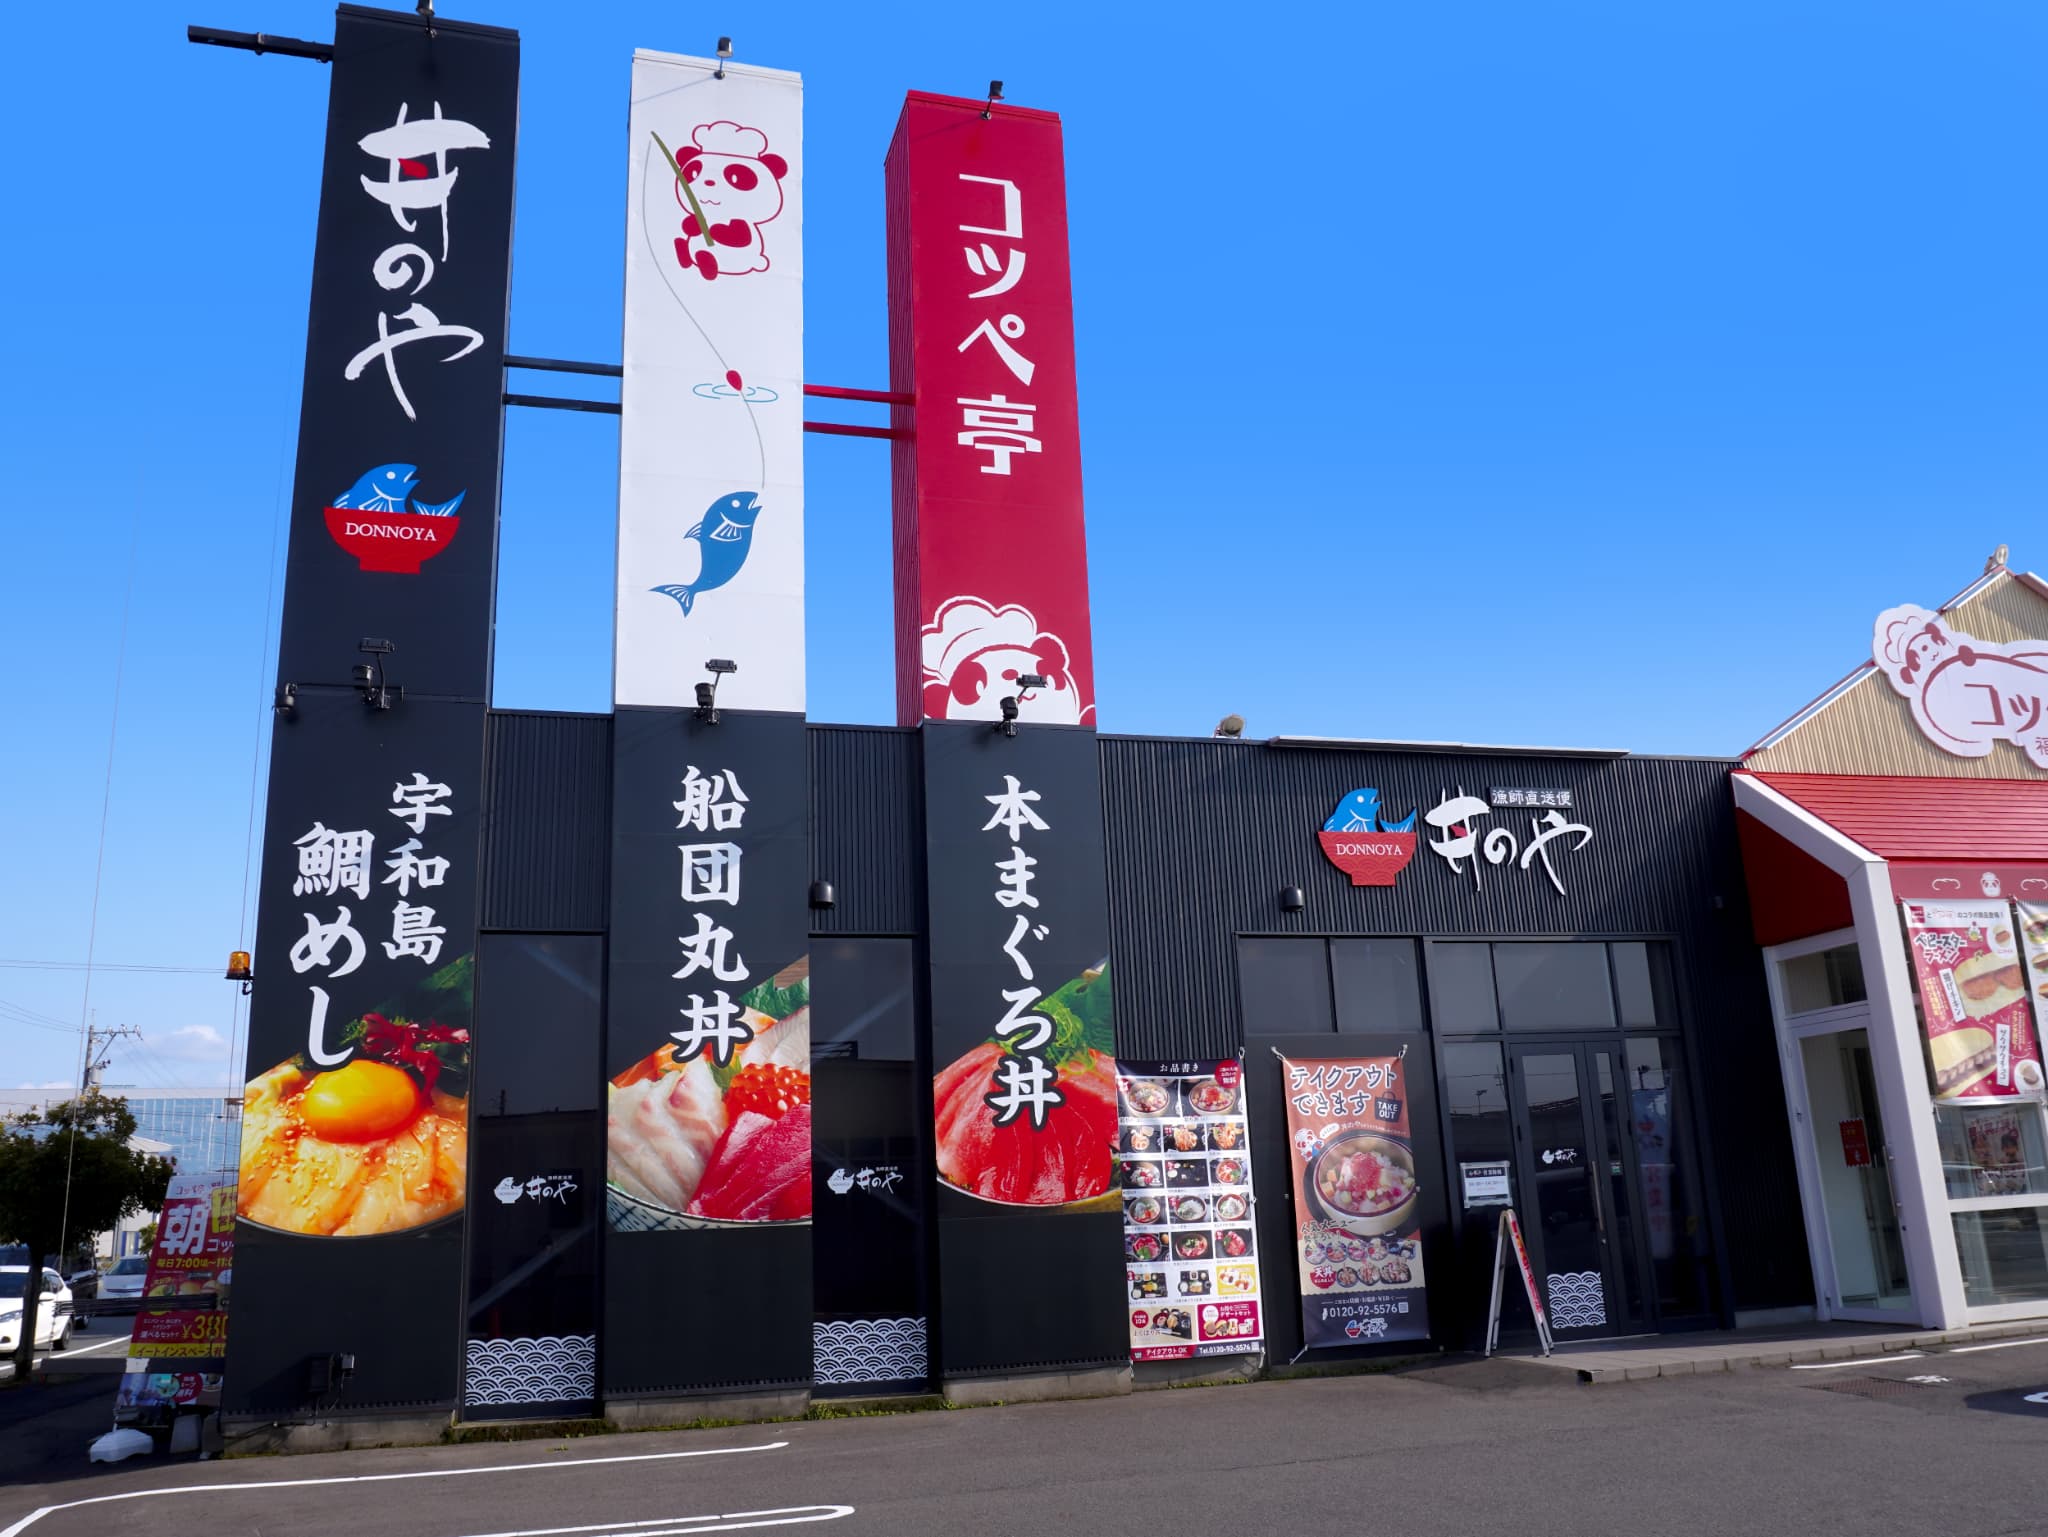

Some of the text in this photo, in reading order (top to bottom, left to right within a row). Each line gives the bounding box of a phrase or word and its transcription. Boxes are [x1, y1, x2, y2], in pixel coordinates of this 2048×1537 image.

[345, 101, 491, 421] 丼のや
[957, 173, 1042, 475] コッペ亭
[346, 521, 437, 542] DONNOYA
[1963, 683, 2048, 733] コッ
[1492, 789, 1572, 806] 漁師直送便
[1336, 843, 1403, 856] DONNOYA
[1424, 785, 1593, 895] 丼のや
[381, 772, 453, 965] 宇和島
[670, 766, 750, 1062] 船団丸丼
[289, 822, 375, 1066] 鯛めし
[982, 775, 1061, 1126] 本まぐろ丼
[1914, 931, 1968, 949] ベビースター
[1924, 946, 1960, 964] ラーメン
[1159, 1062, 1199, 1073] お品書き
[1291, 1064, 1397, 1090] テイクアウト
[1293, 1091, 1371, 1116] できます
[1377, 1101, 1399, 1112] TAKE
[1379, 1111, 1396, 1119] OUT
[160, 1204, 208, 1255] 朝
[1329, 1303, 1398, 1318] 0120-92-5576
